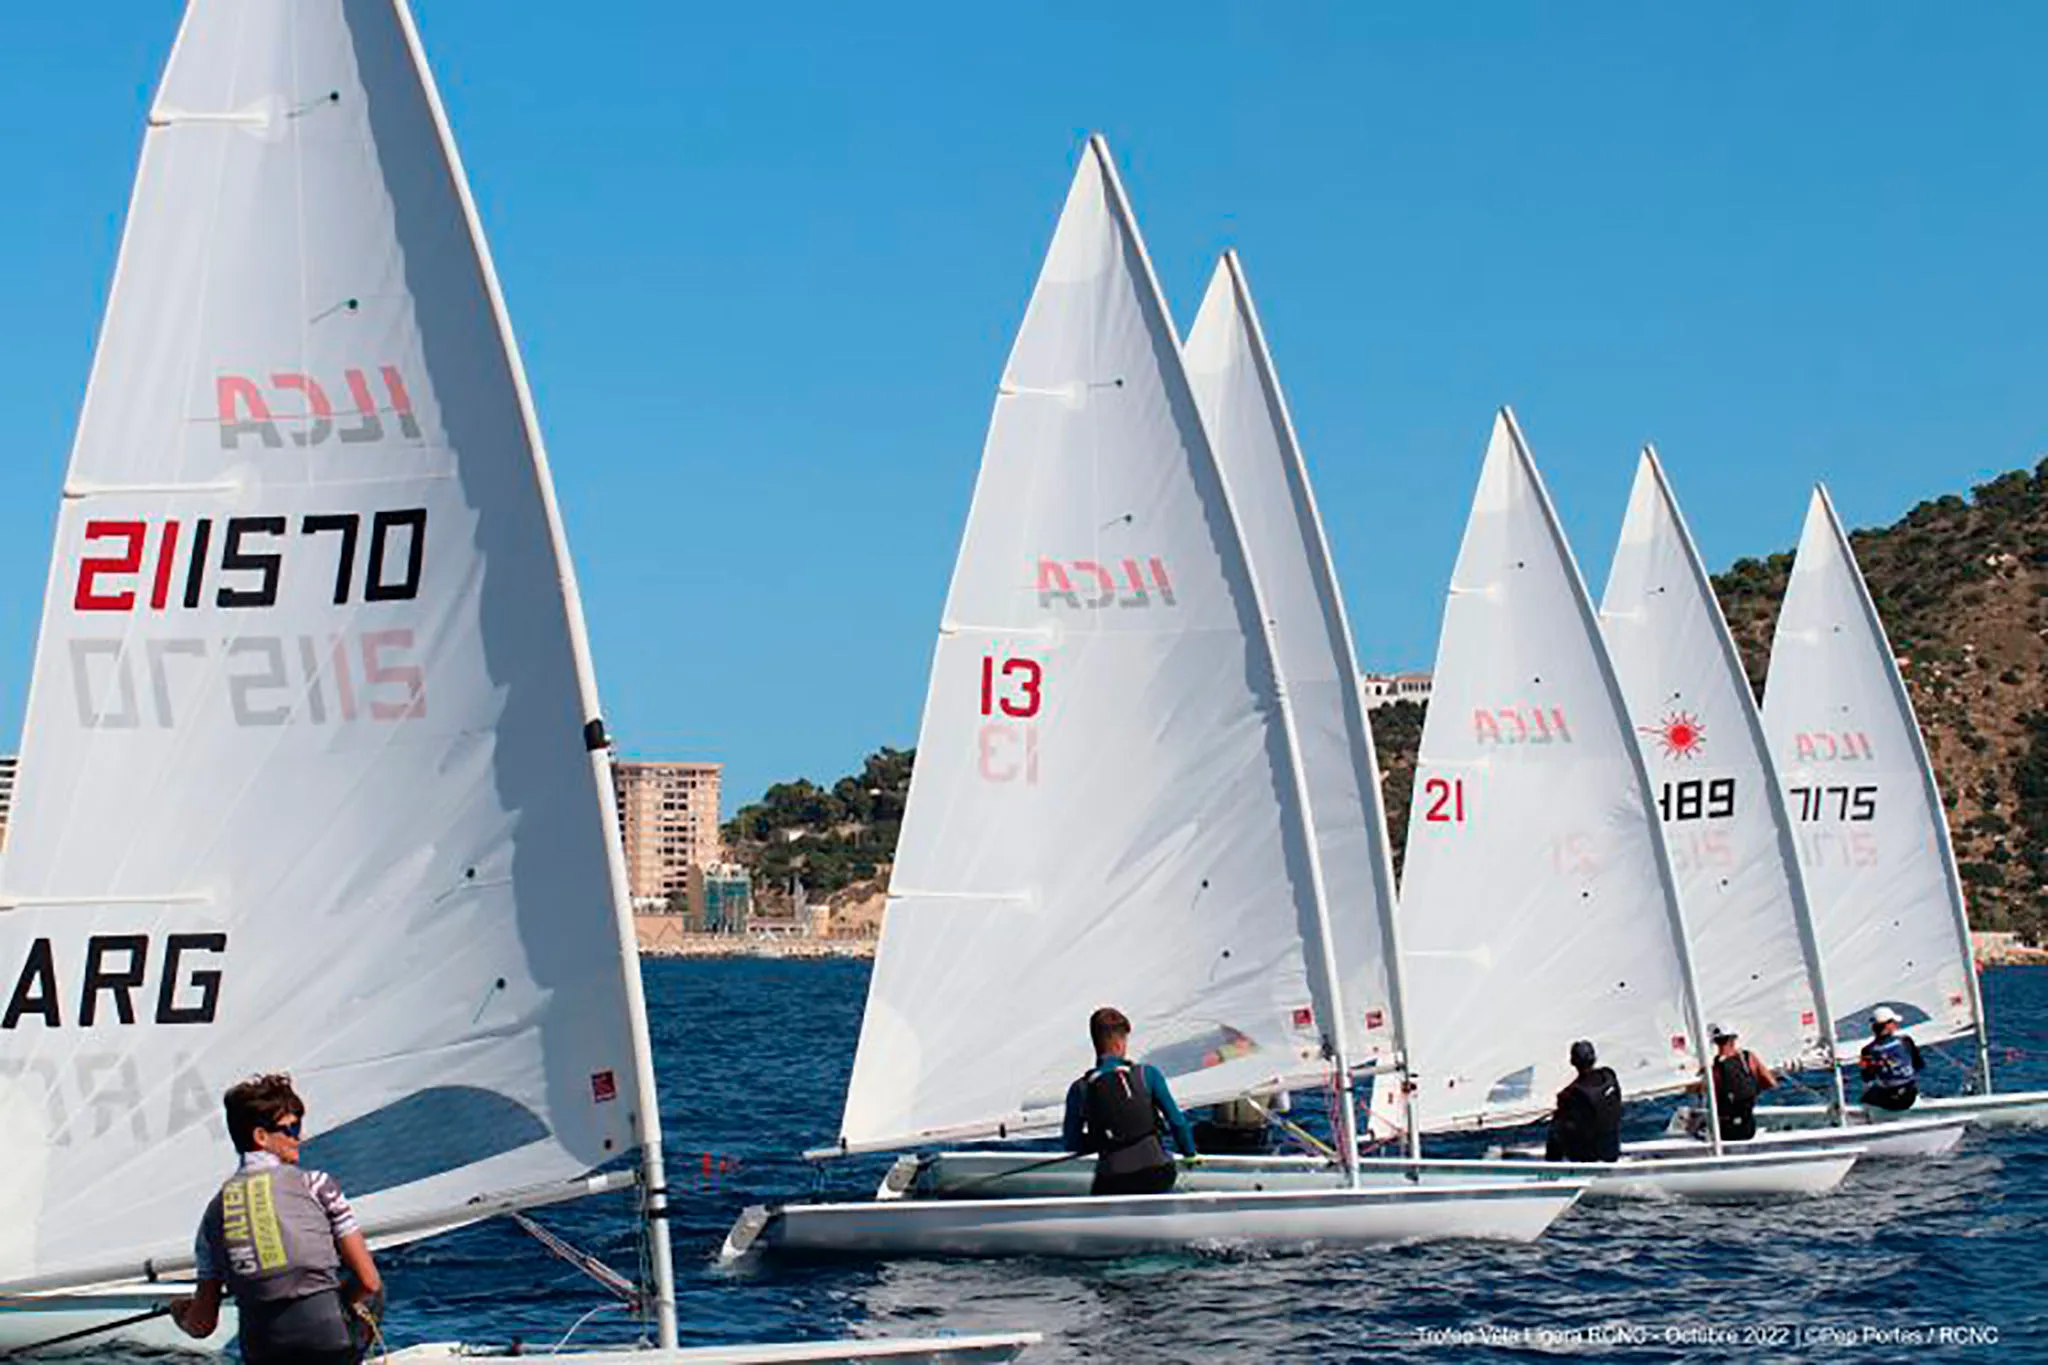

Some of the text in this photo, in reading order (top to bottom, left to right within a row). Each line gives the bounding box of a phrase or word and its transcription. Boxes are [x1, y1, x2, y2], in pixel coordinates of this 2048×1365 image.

[74, 508, 427, 611] 211570
[980, 655, 1041, 717] 13
[1425, 778, 1464, 822] 21
[1789, 786, 1878, 821] 7175
[2, 933, 227, 1029] ARG
